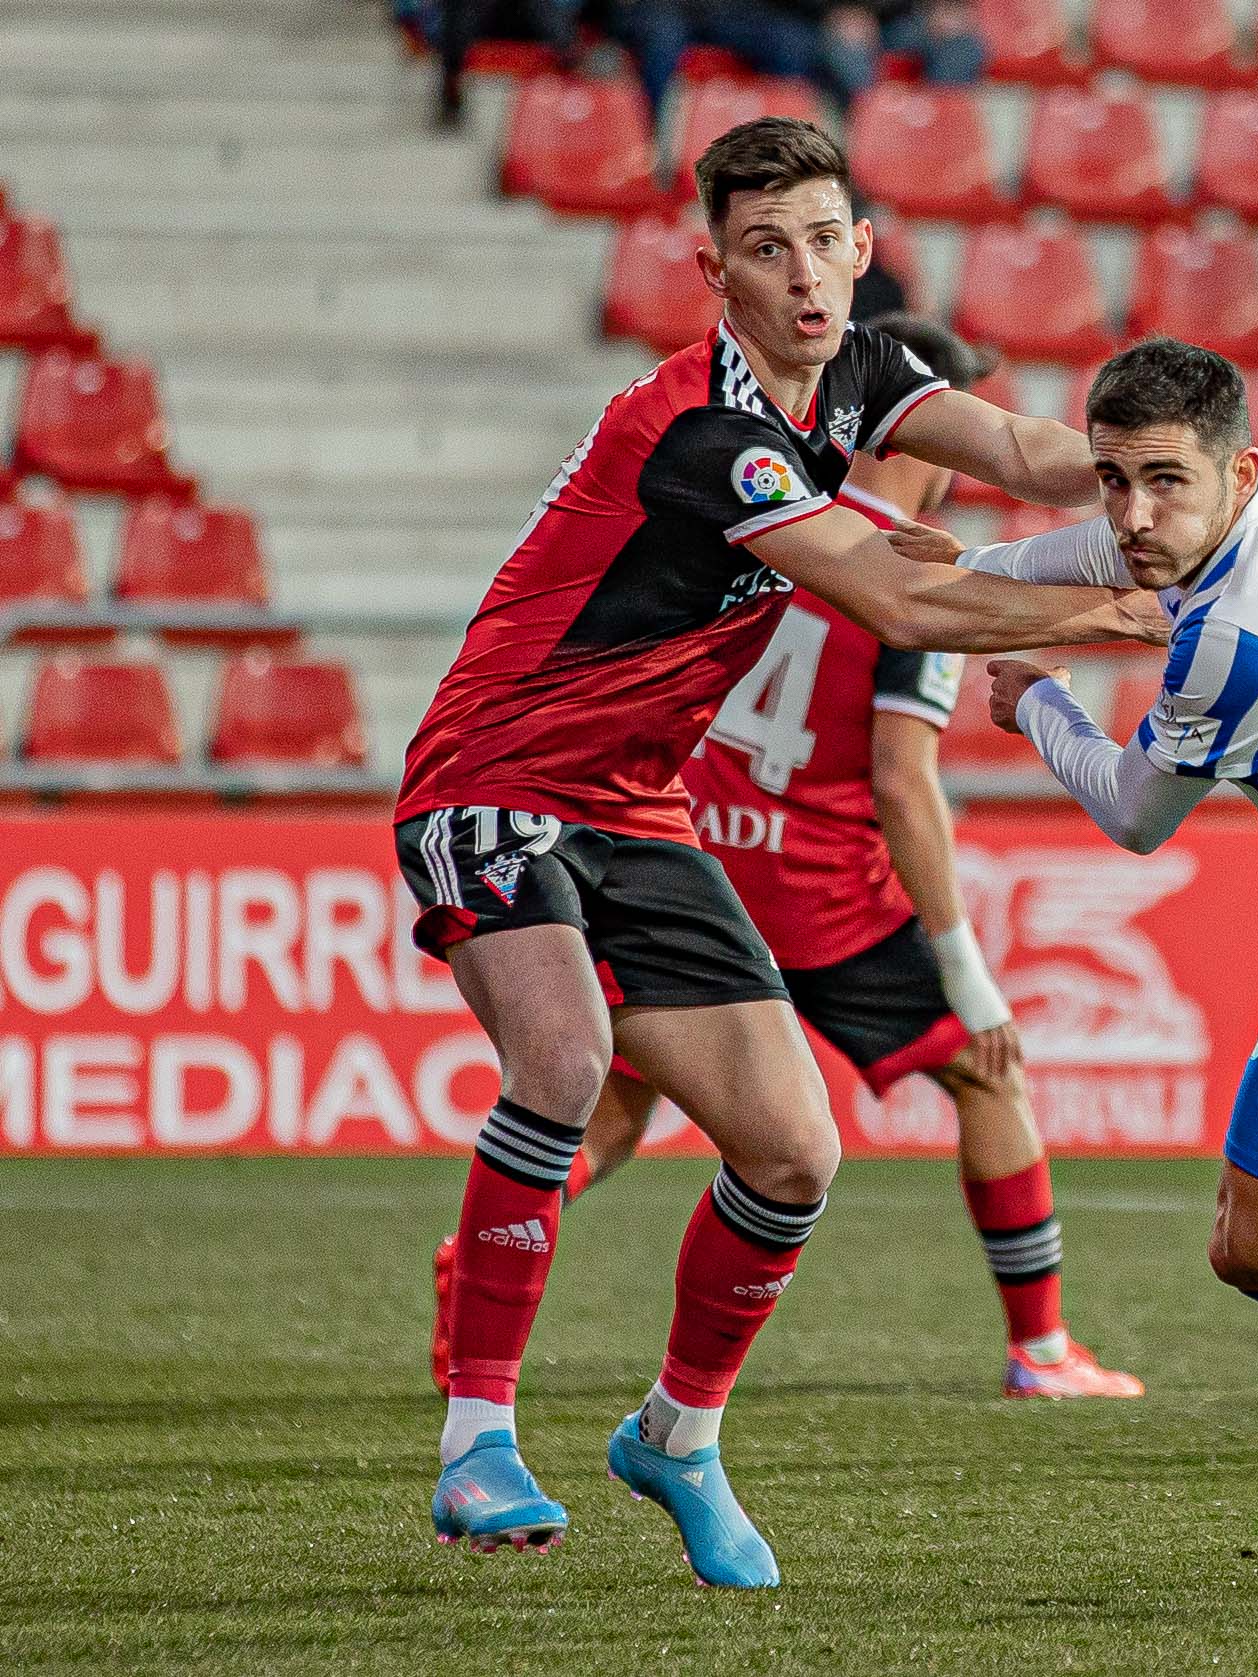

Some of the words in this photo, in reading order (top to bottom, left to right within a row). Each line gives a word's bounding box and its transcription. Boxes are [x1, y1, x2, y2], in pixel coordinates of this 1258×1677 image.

[696, 602, 830, 796] 4
[462, 805, 562, 857] 19
[689, 797, 787, 854] ADI
[0, 865, 468, 1014] GUIRRE
[478, 1228, 550, 1254] adidas
